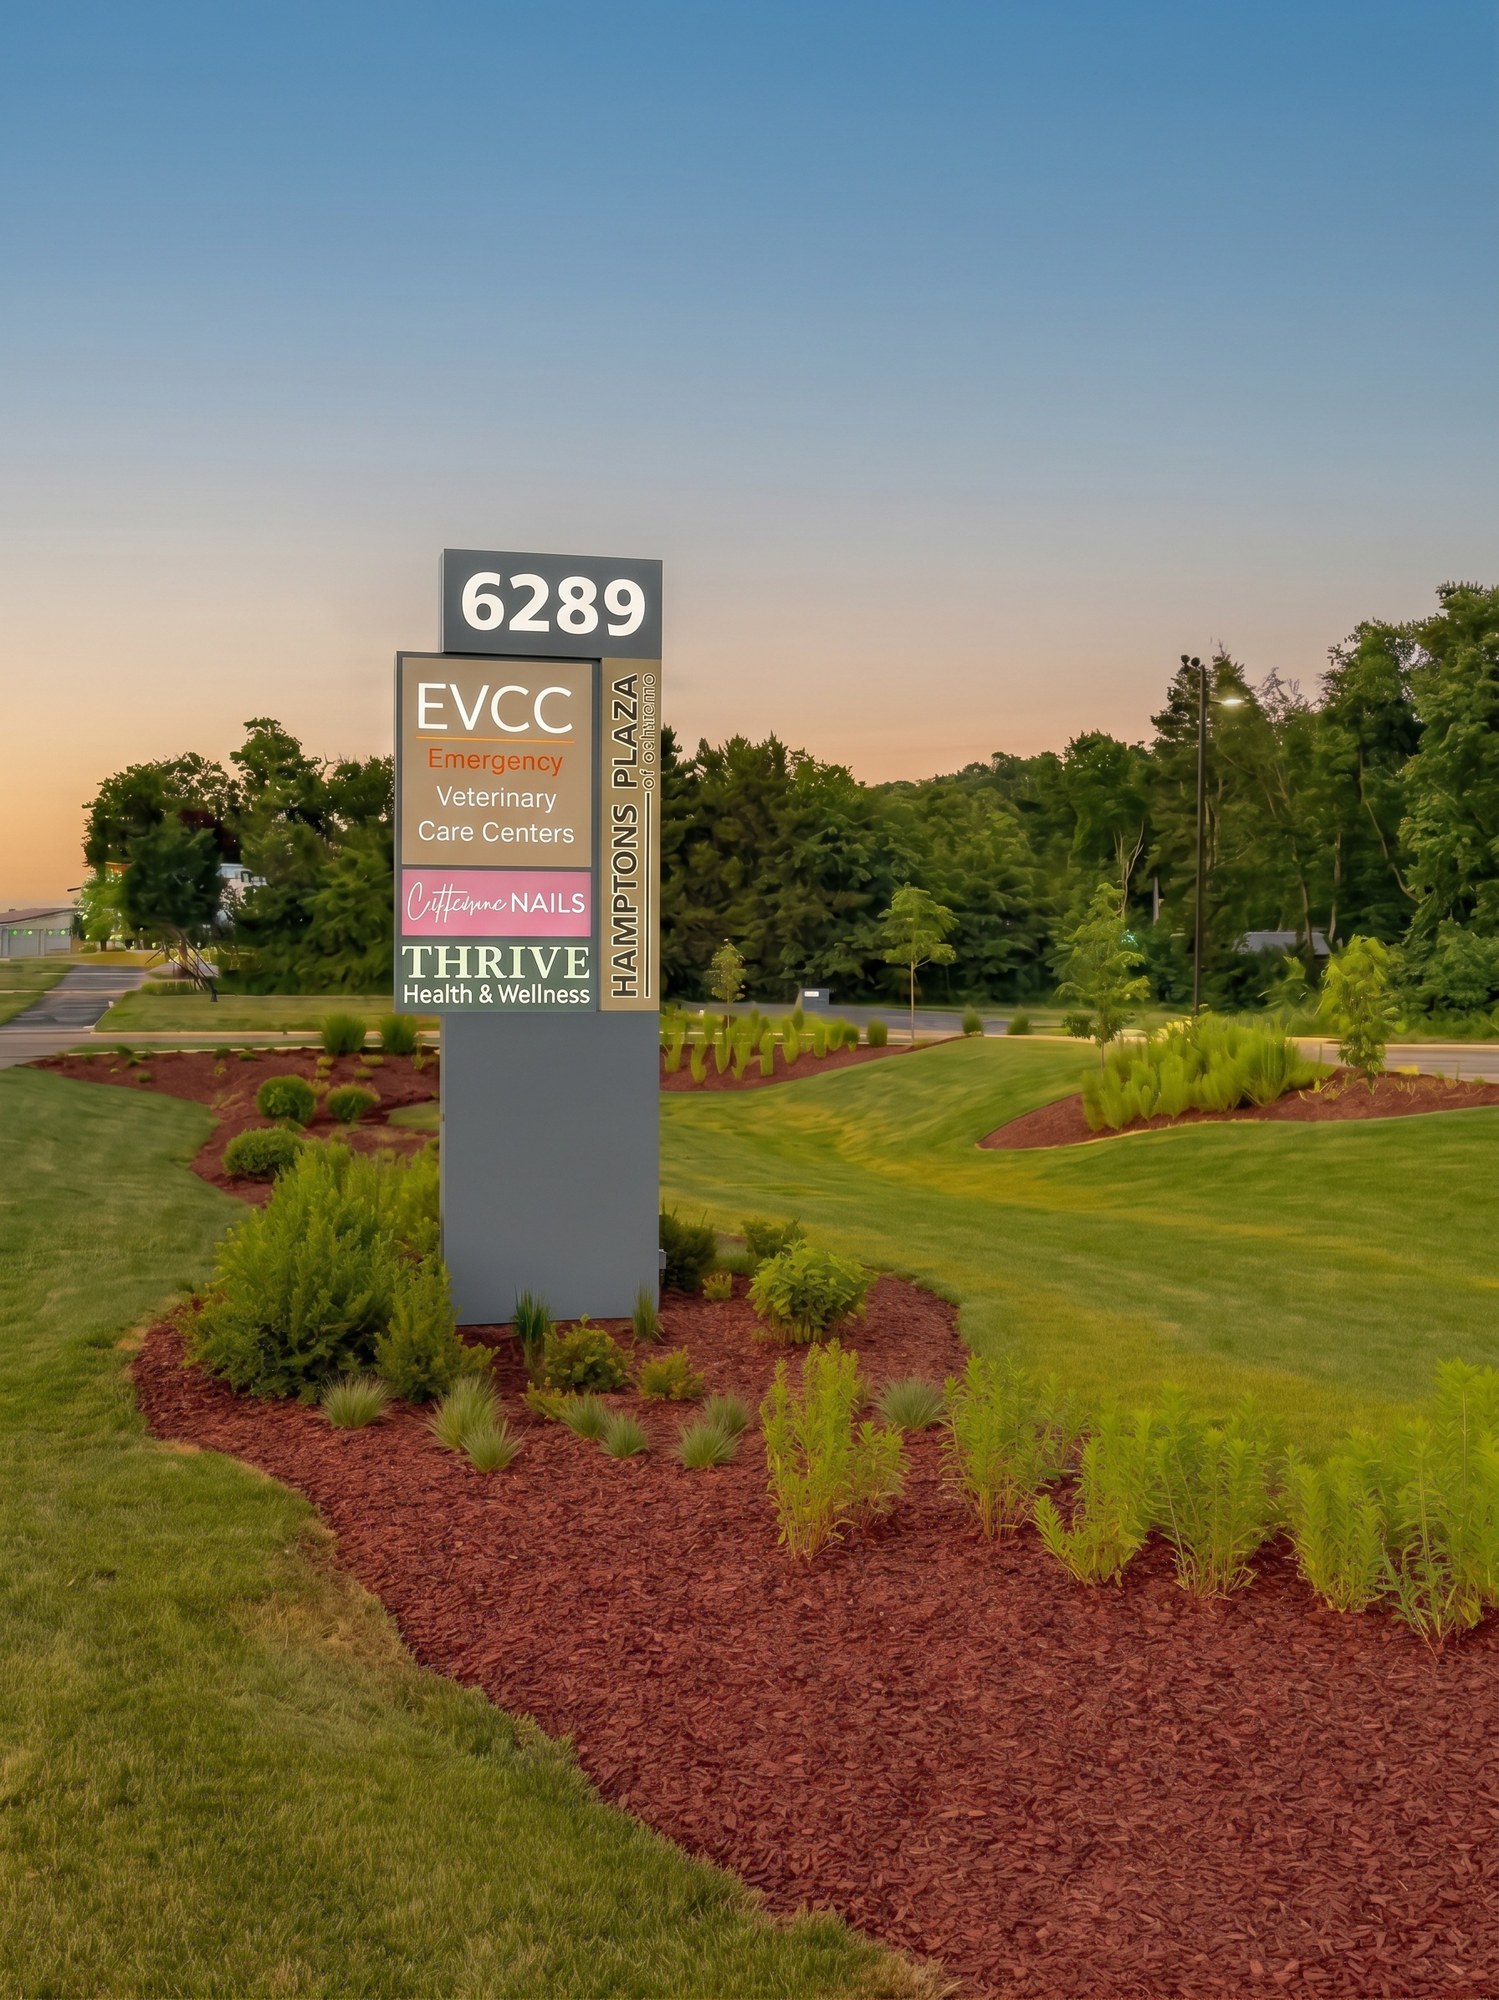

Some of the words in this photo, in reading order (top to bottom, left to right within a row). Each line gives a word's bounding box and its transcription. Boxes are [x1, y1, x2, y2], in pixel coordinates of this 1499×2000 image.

[461, 571, 646, 636] 6289
[418, 682, 573, 734] EVCC
[611, 672, 638, 789] PLAZA
[428, 748, 563, 776] Emergency
[639, 768, 655, 790] of
[436, 785, 557, 813] Veterinary
[418, 820, 474, 841] Care
[482, 822, 575, 843] Centers
[511, 892, 586, 914] NAILS
[611, 803, 638, 998] HAMPTONS
[401, 945, 590, 979] THRIVE
[403, 983, 473, 1004] Health
[478, 984, 494, 1004] &
[498, 983, 591, 1004] Wellness
